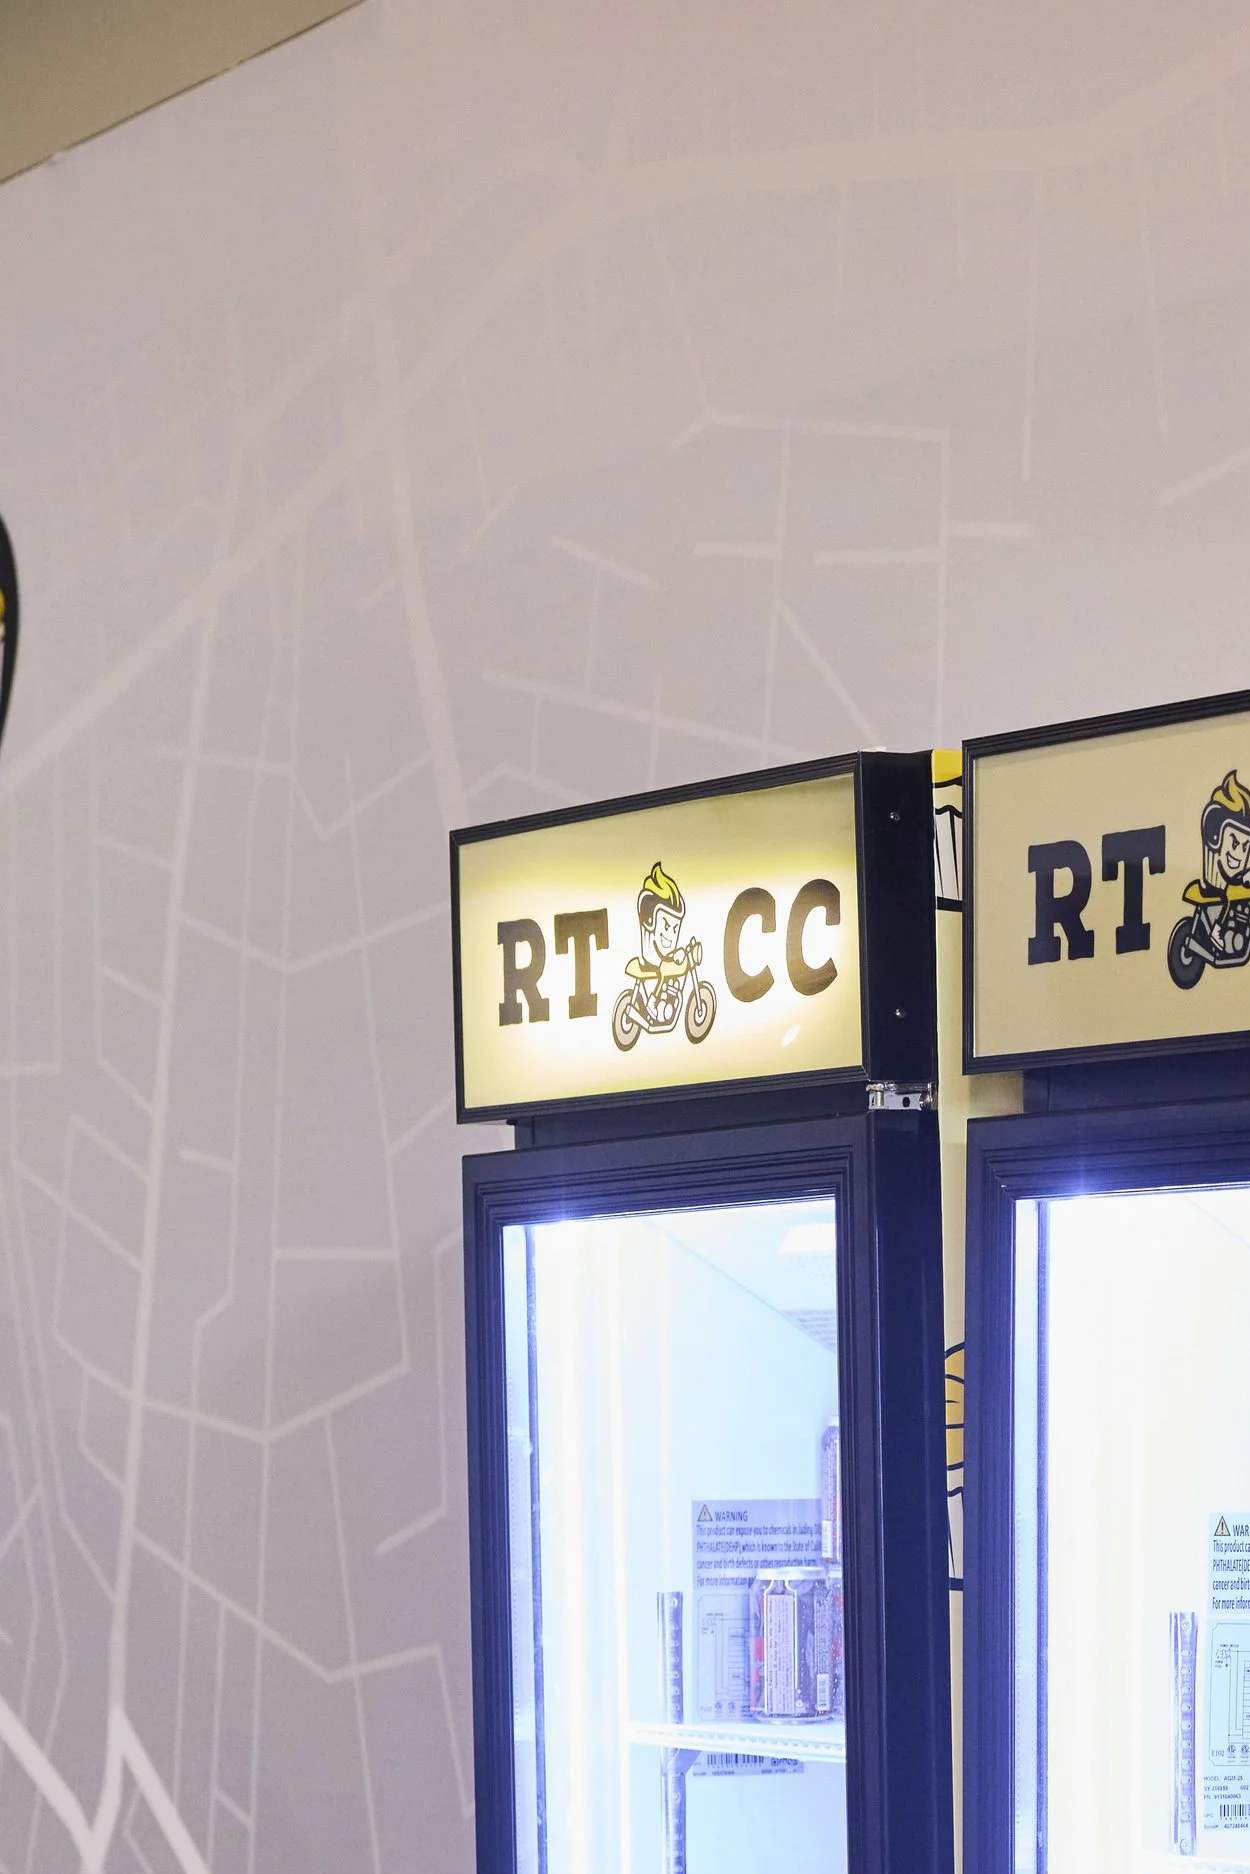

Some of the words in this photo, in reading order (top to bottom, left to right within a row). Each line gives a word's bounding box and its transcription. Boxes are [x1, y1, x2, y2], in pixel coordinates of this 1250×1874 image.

[1026, 825, 1168, 967] RT
[496, 909, 611, 1027] RT
[722, 876, 843, 1004] CC
[714, 1510, 748, 1522] WARNING
[707, 1525, 725, 1539] product
[1213, 1540, 1223, 1552] This
[1224, 1540, 1244, 1555] product
[1213, 1580, 1229, 1590] cancer
[1230, 1577, 1240, 1590] and
[1213, 1597, 1221, 1609] For
[1222, 1600, 1234, 1609] more
